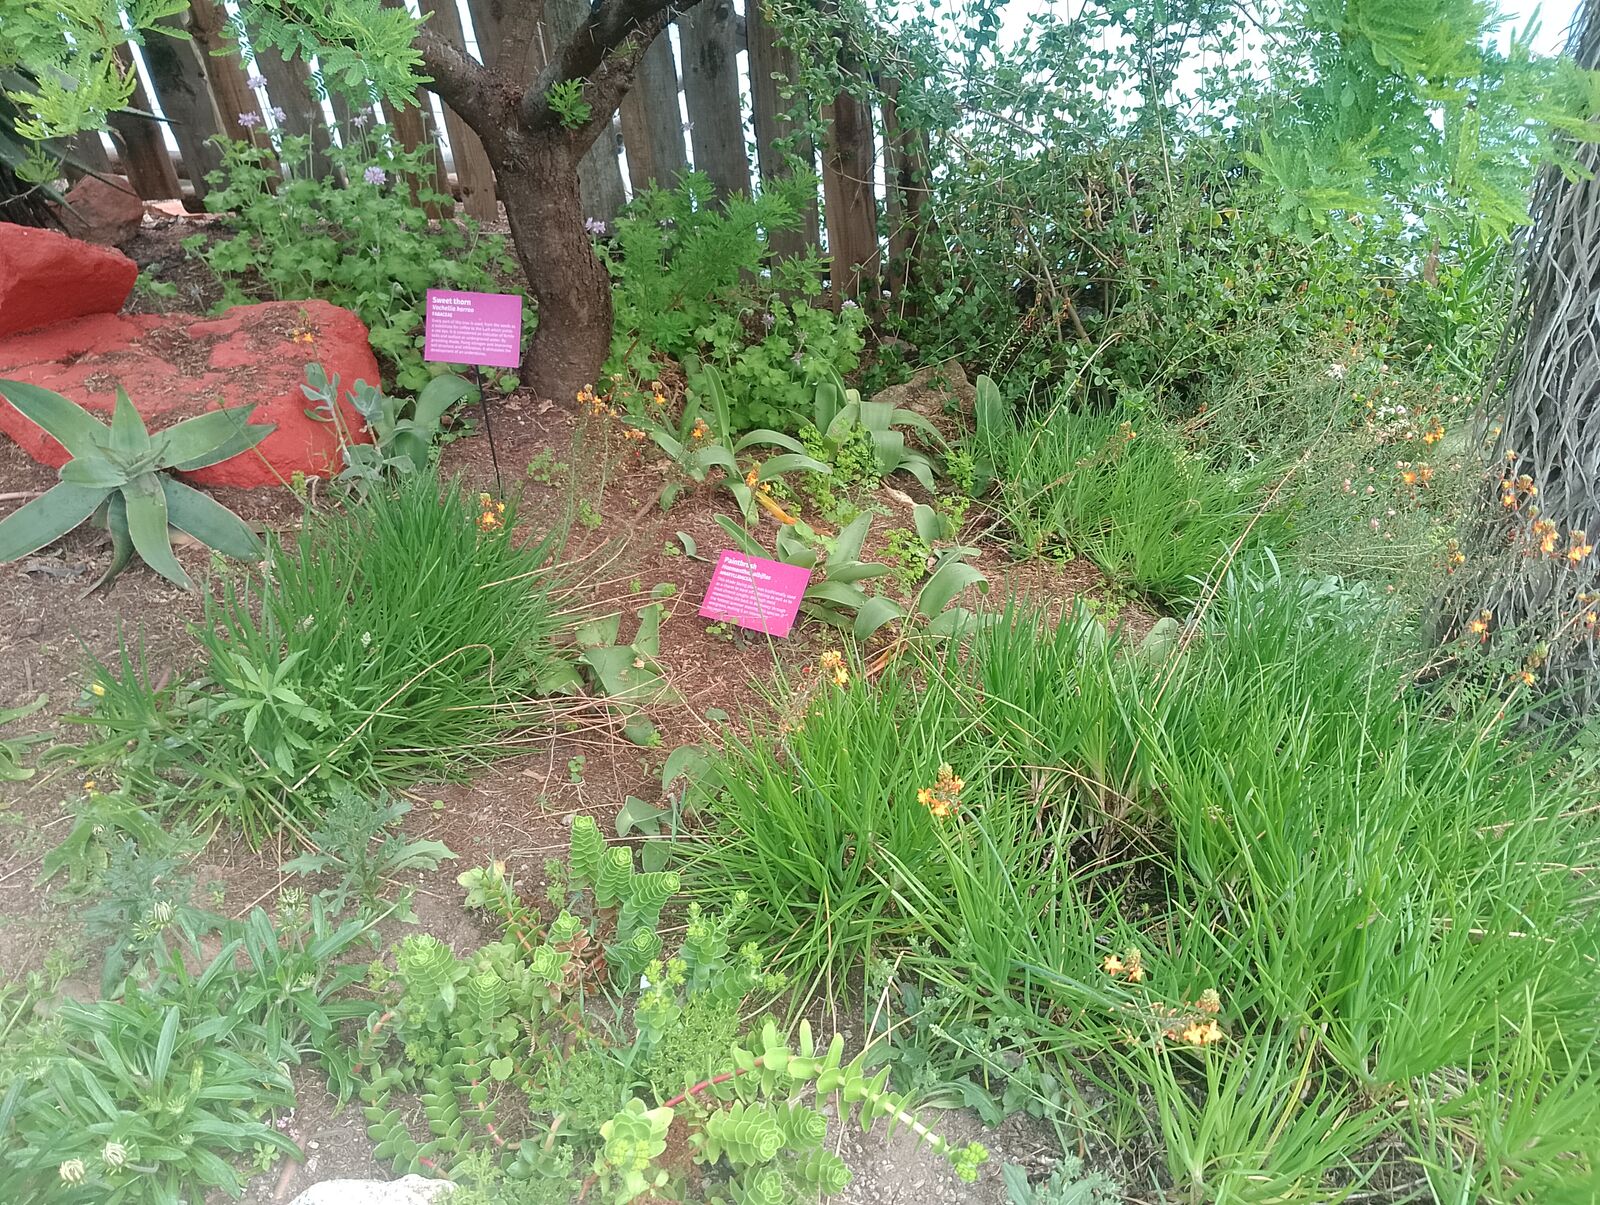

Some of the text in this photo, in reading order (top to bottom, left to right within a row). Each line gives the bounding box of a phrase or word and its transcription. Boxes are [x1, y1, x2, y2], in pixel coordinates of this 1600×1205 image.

[432, 296, 452, 304] Sweet
[724, 556, 757, 570] Paintbrush
[721, 564, 752, 576] Haemanthu
[720, 571, 753, 582] AMARYLLIDACEA
